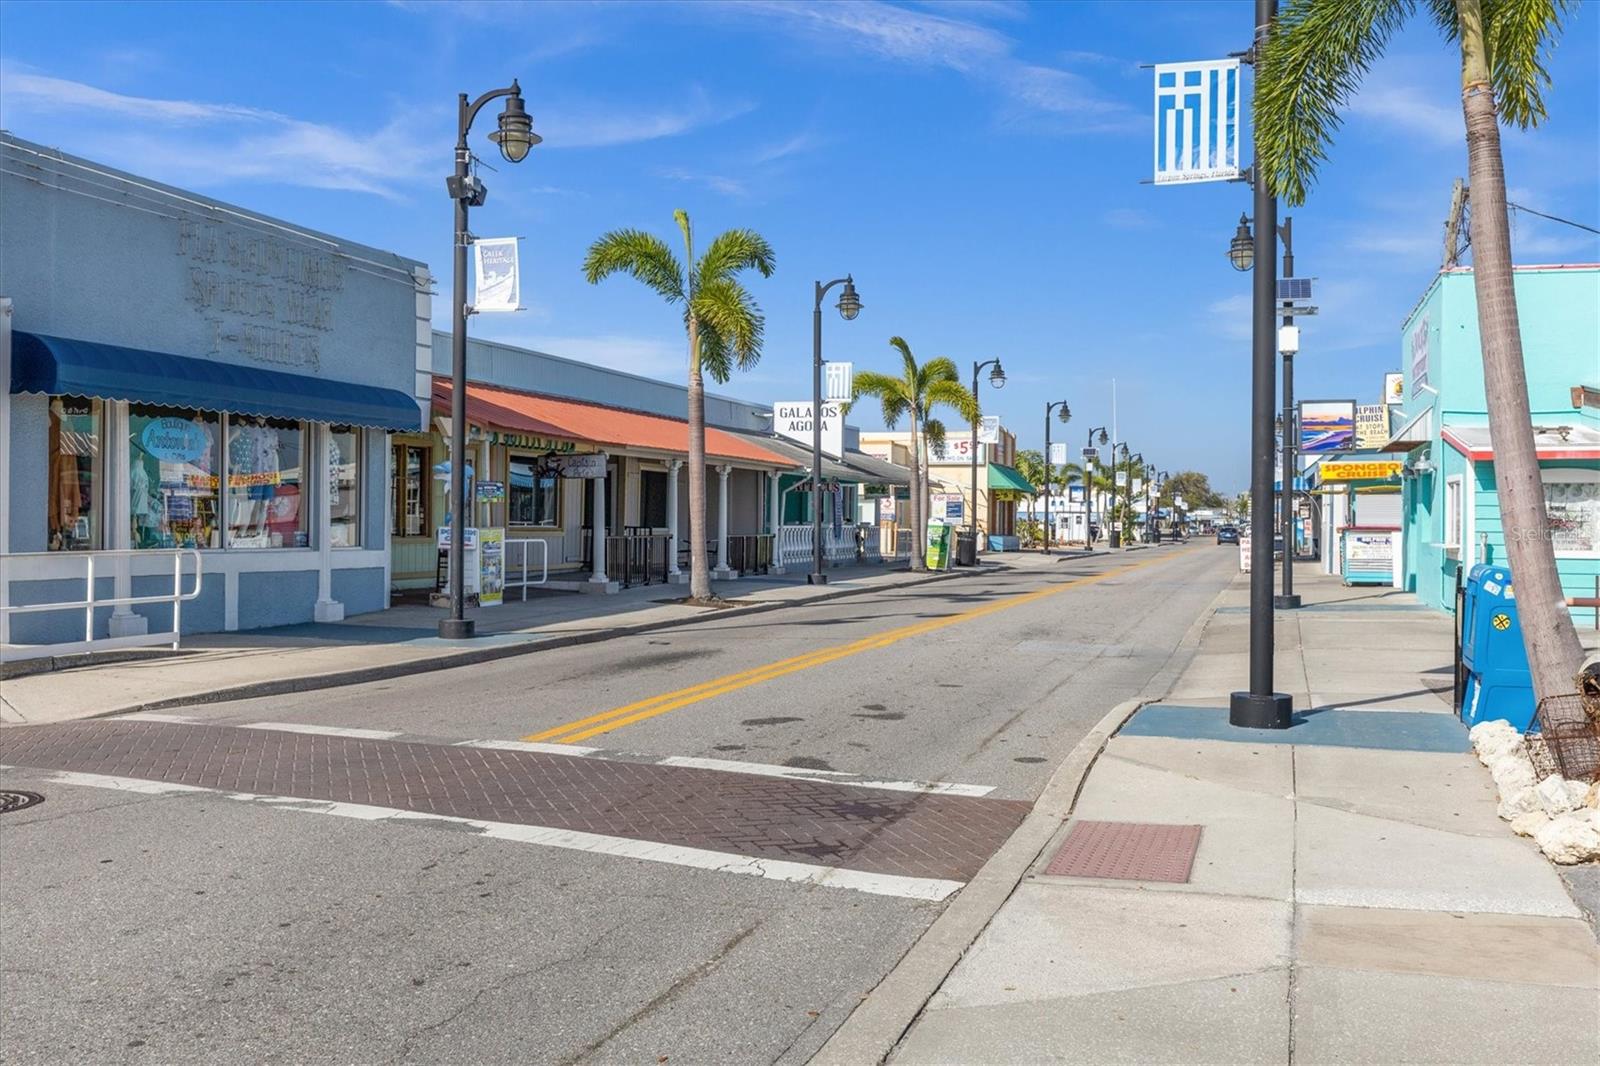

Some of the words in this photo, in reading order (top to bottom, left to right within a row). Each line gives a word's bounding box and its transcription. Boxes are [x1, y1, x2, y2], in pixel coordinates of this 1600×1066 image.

[779, 406, 837, 418] GALAOS
[788, 420, 828, 431] AGOA
[1325, 462, 1402, 473] SPONGEO
